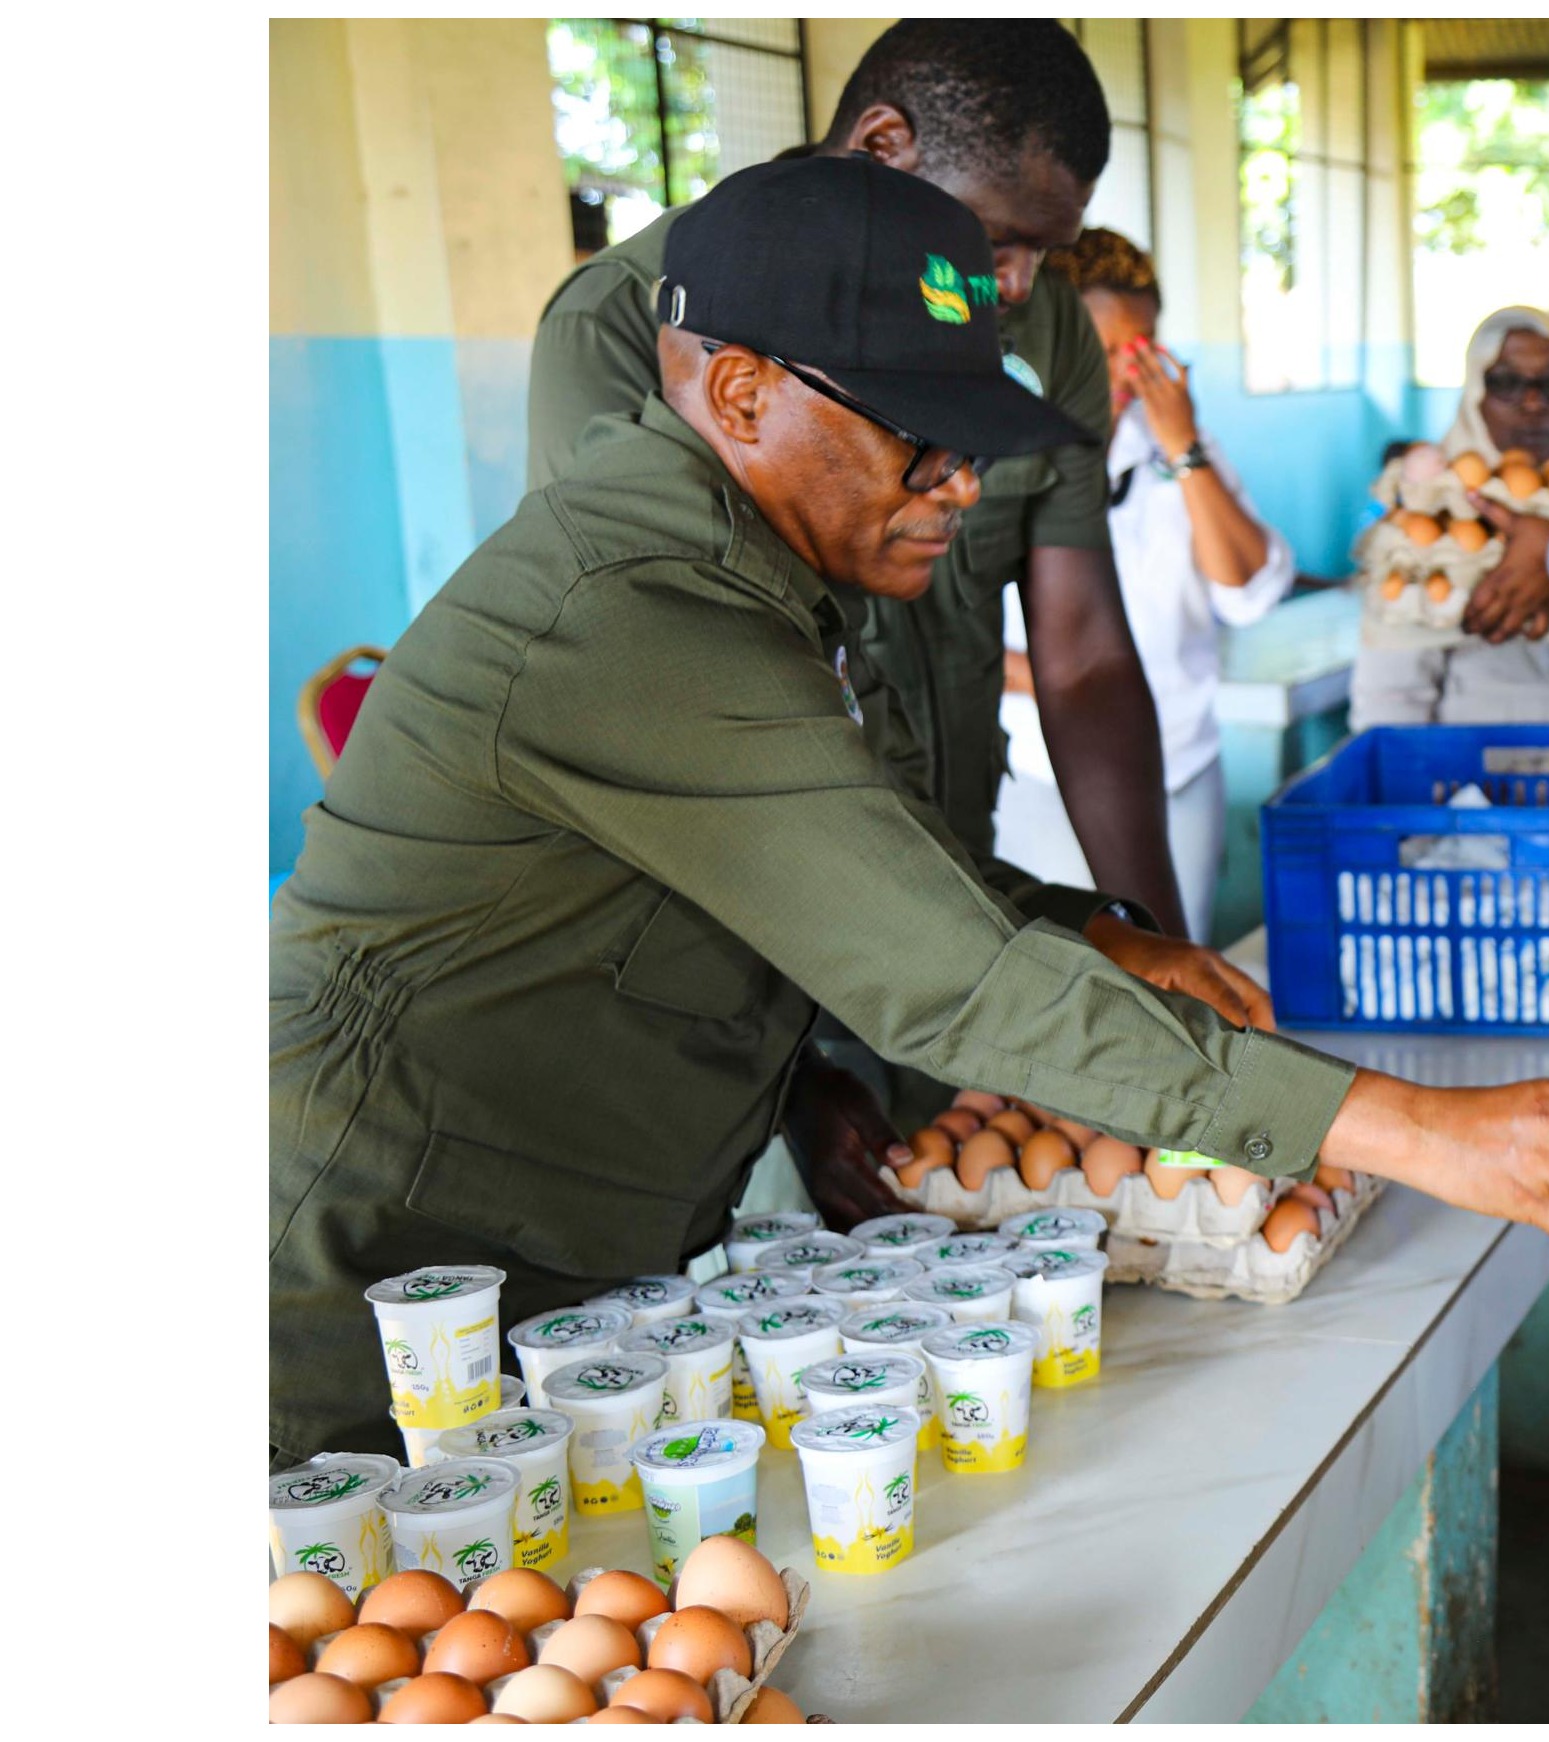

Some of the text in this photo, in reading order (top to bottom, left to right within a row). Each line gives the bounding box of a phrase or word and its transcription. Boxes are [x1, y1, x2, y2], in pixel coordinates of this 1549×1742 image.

[521, 1542, 550, 1558] Vanilla
[522, 1548, 553, 1566] Yoghurt
[459, 1572, 482, 1584] TANGA
